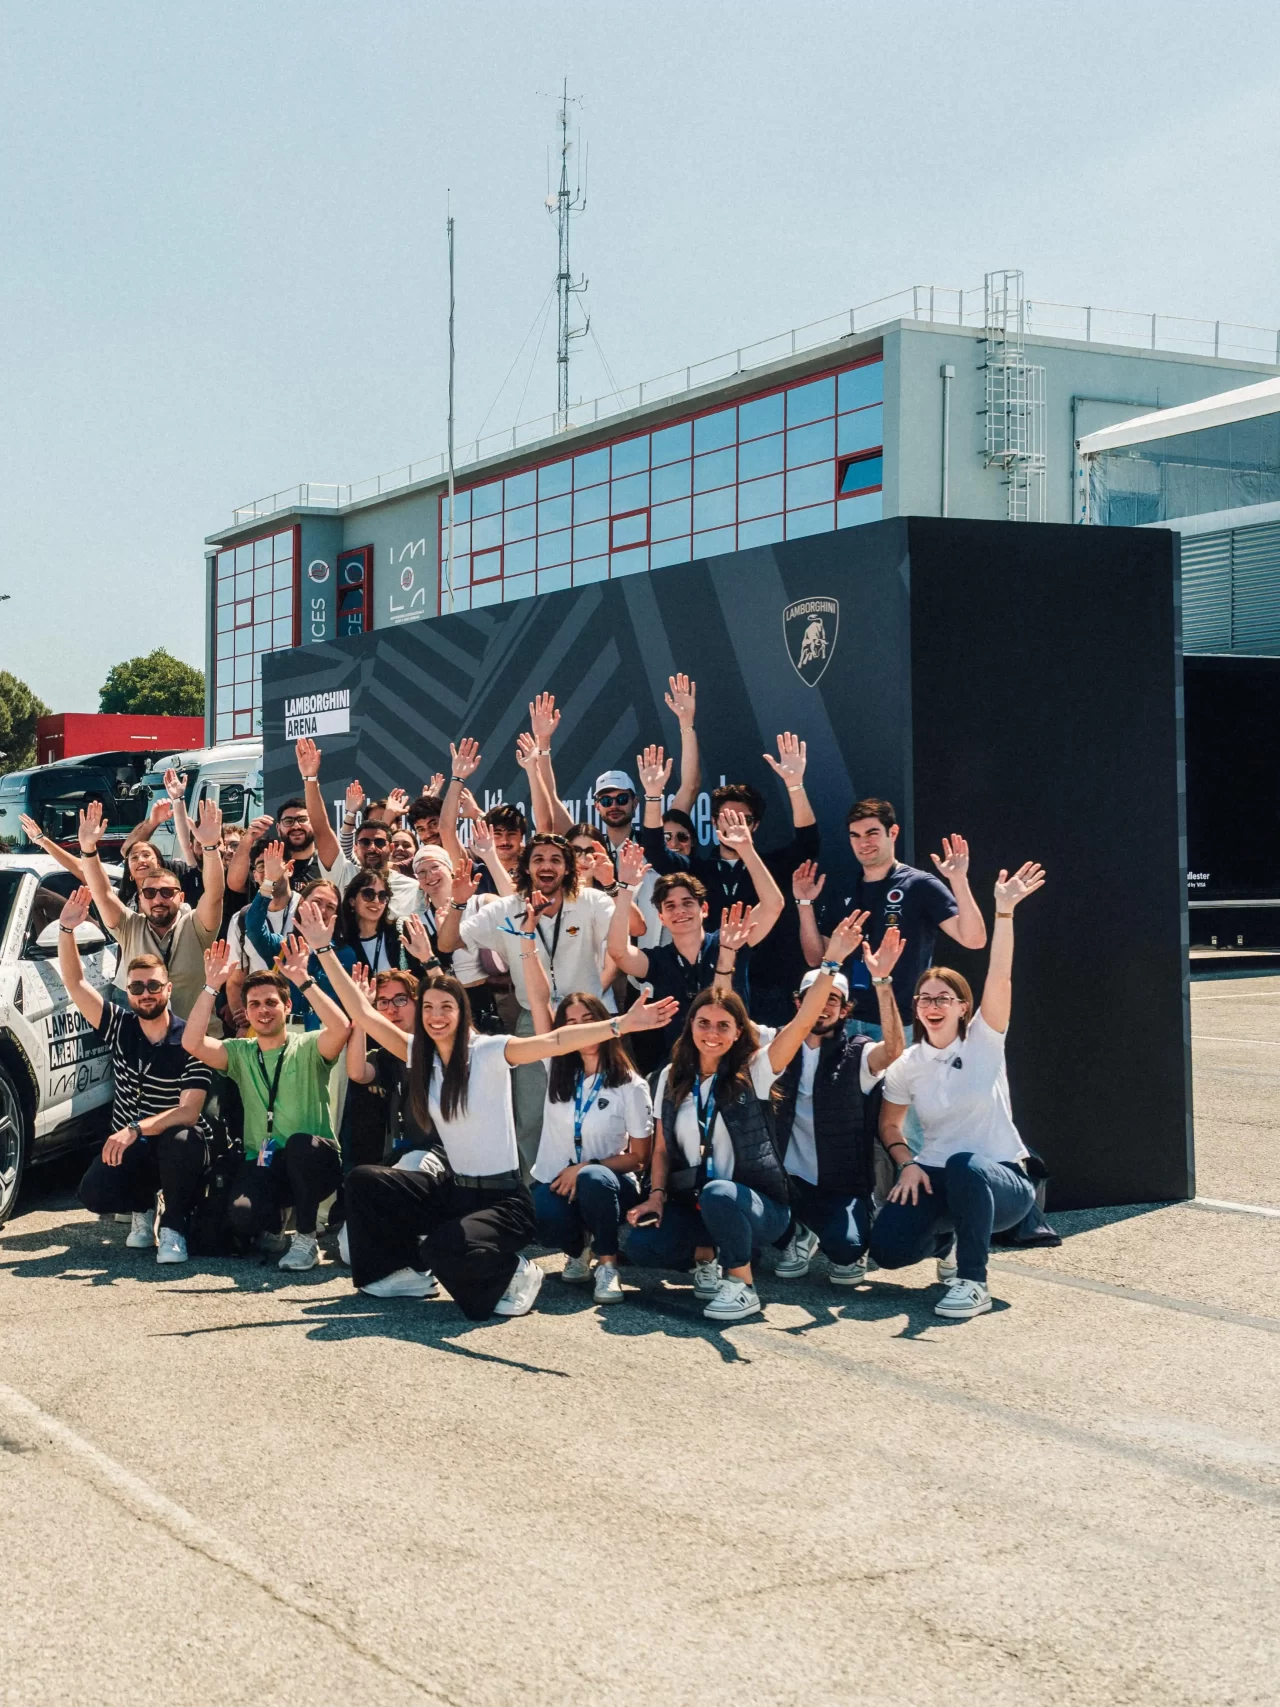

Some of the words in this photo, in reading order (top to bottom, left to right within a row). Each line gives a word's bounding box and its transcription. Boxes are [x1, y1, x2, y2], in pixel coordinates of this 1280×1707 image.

[786, 601, 836, 621] LAMBORGHINI
[285, 689, 350, 717] LAMBORGHINI
[287, 717, 317, 737] ARENA
[45, 1011, 94, 1039] LAMBOR
[51, 1039, 84, 1068] ARENA
